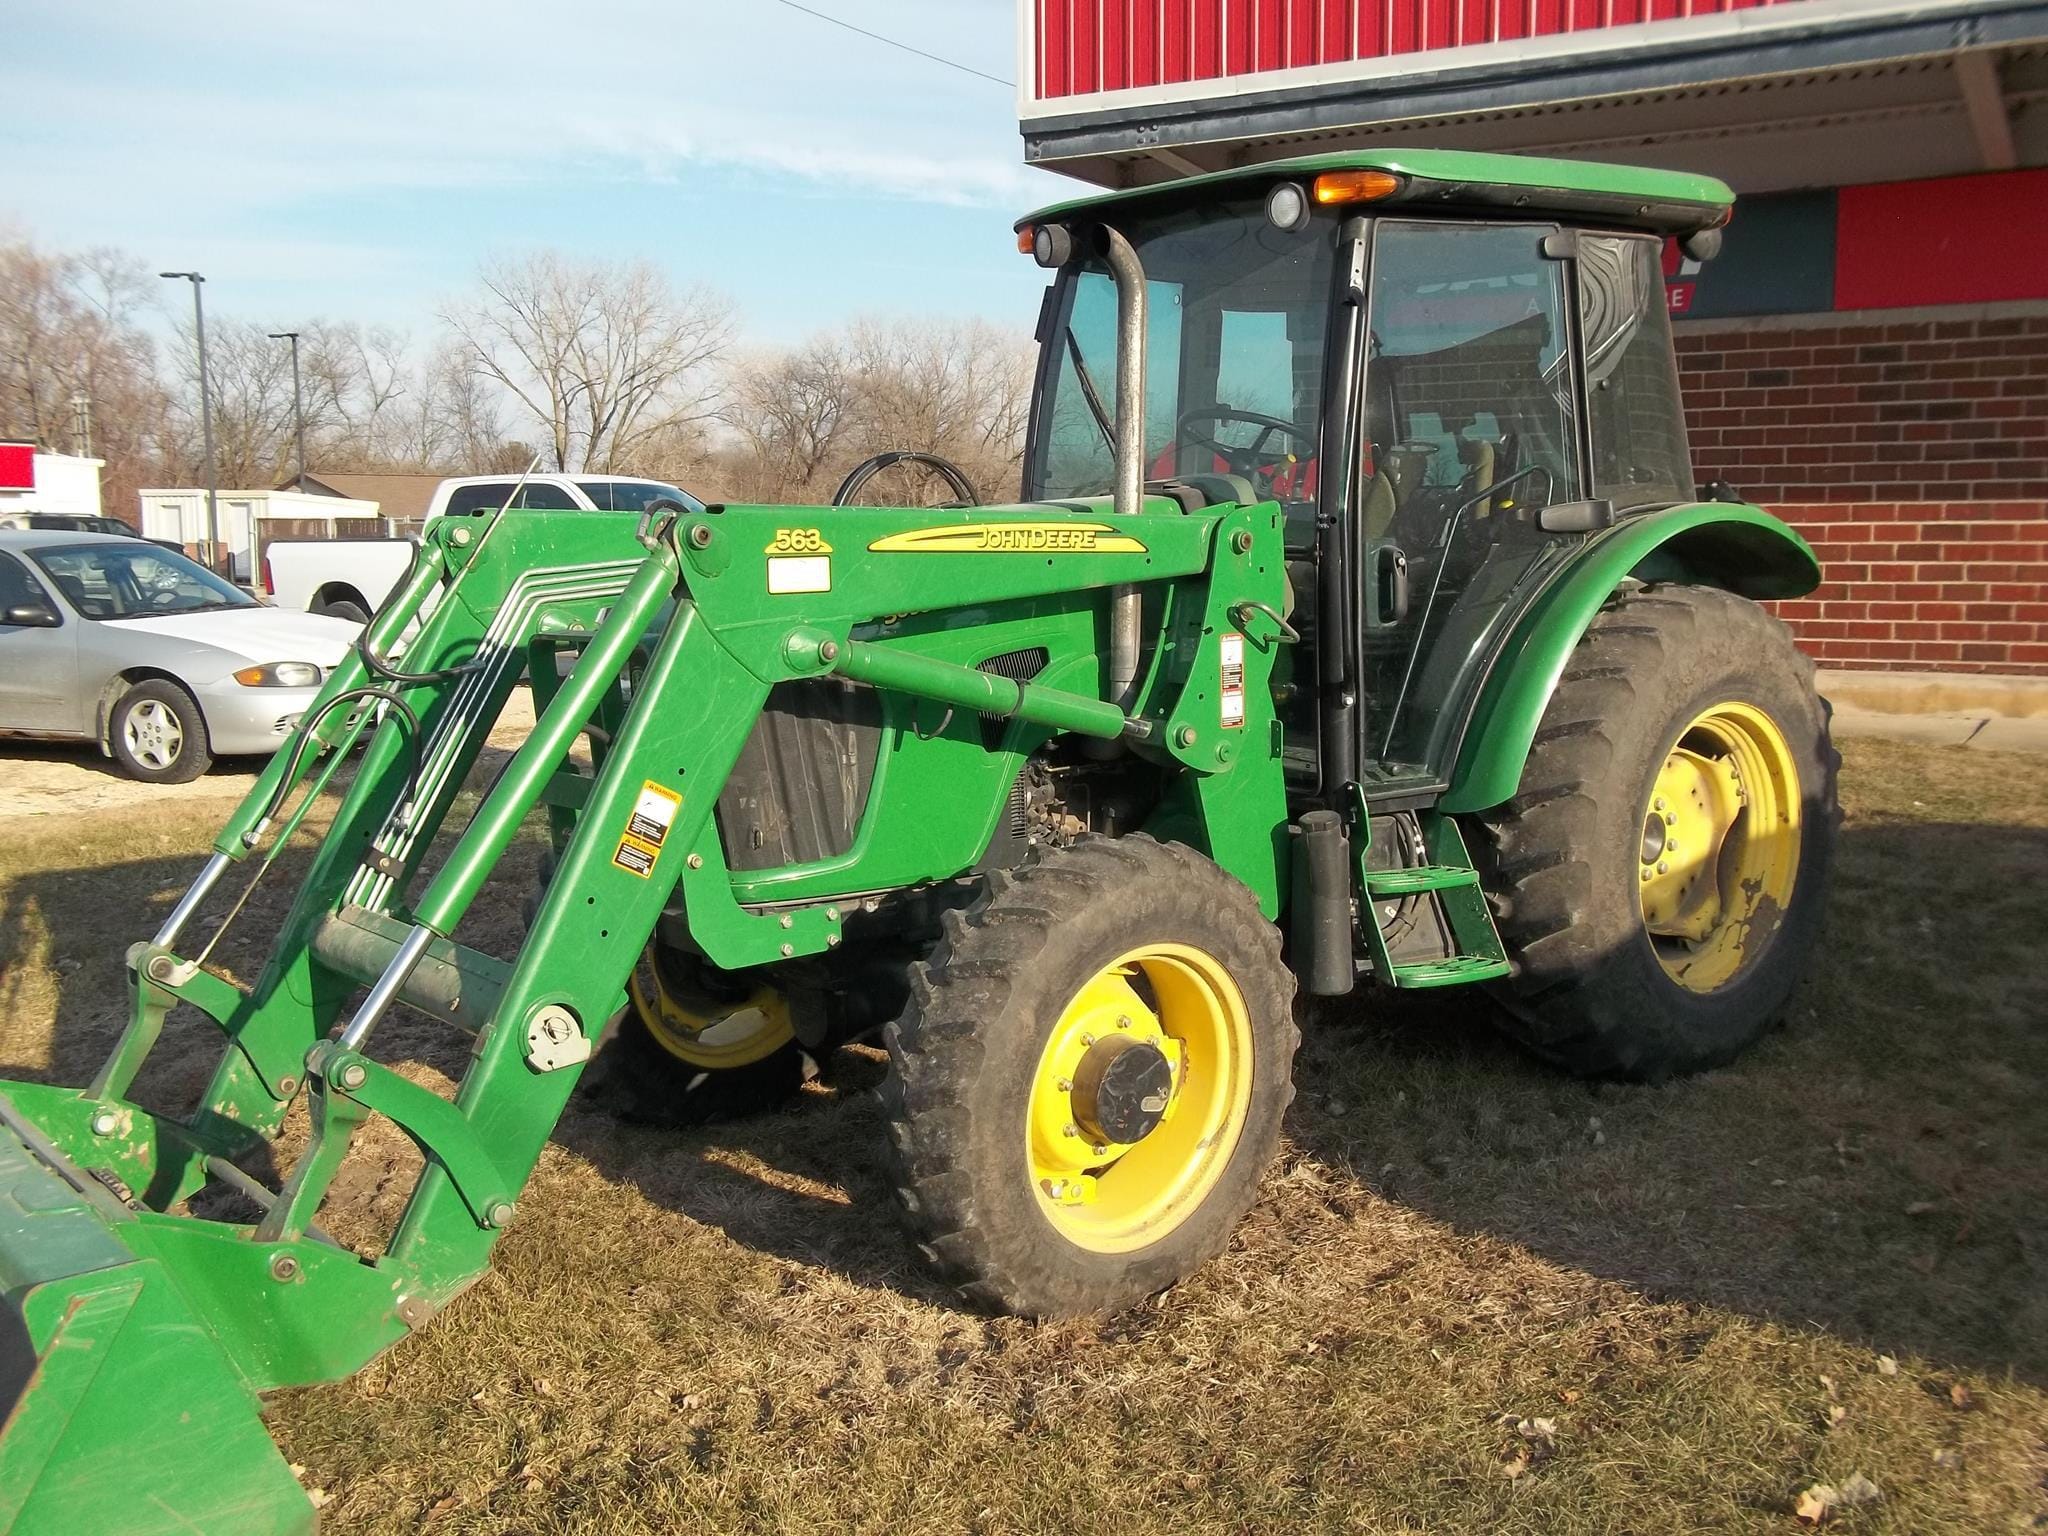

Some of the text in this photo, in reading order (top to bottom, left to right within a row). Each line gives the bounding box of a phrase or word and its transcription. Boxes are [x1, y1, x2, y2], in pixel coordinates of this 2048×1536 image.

[776, 528, 821, 551] 563
[976, 527, 1097, 549] JOHN DEERE
